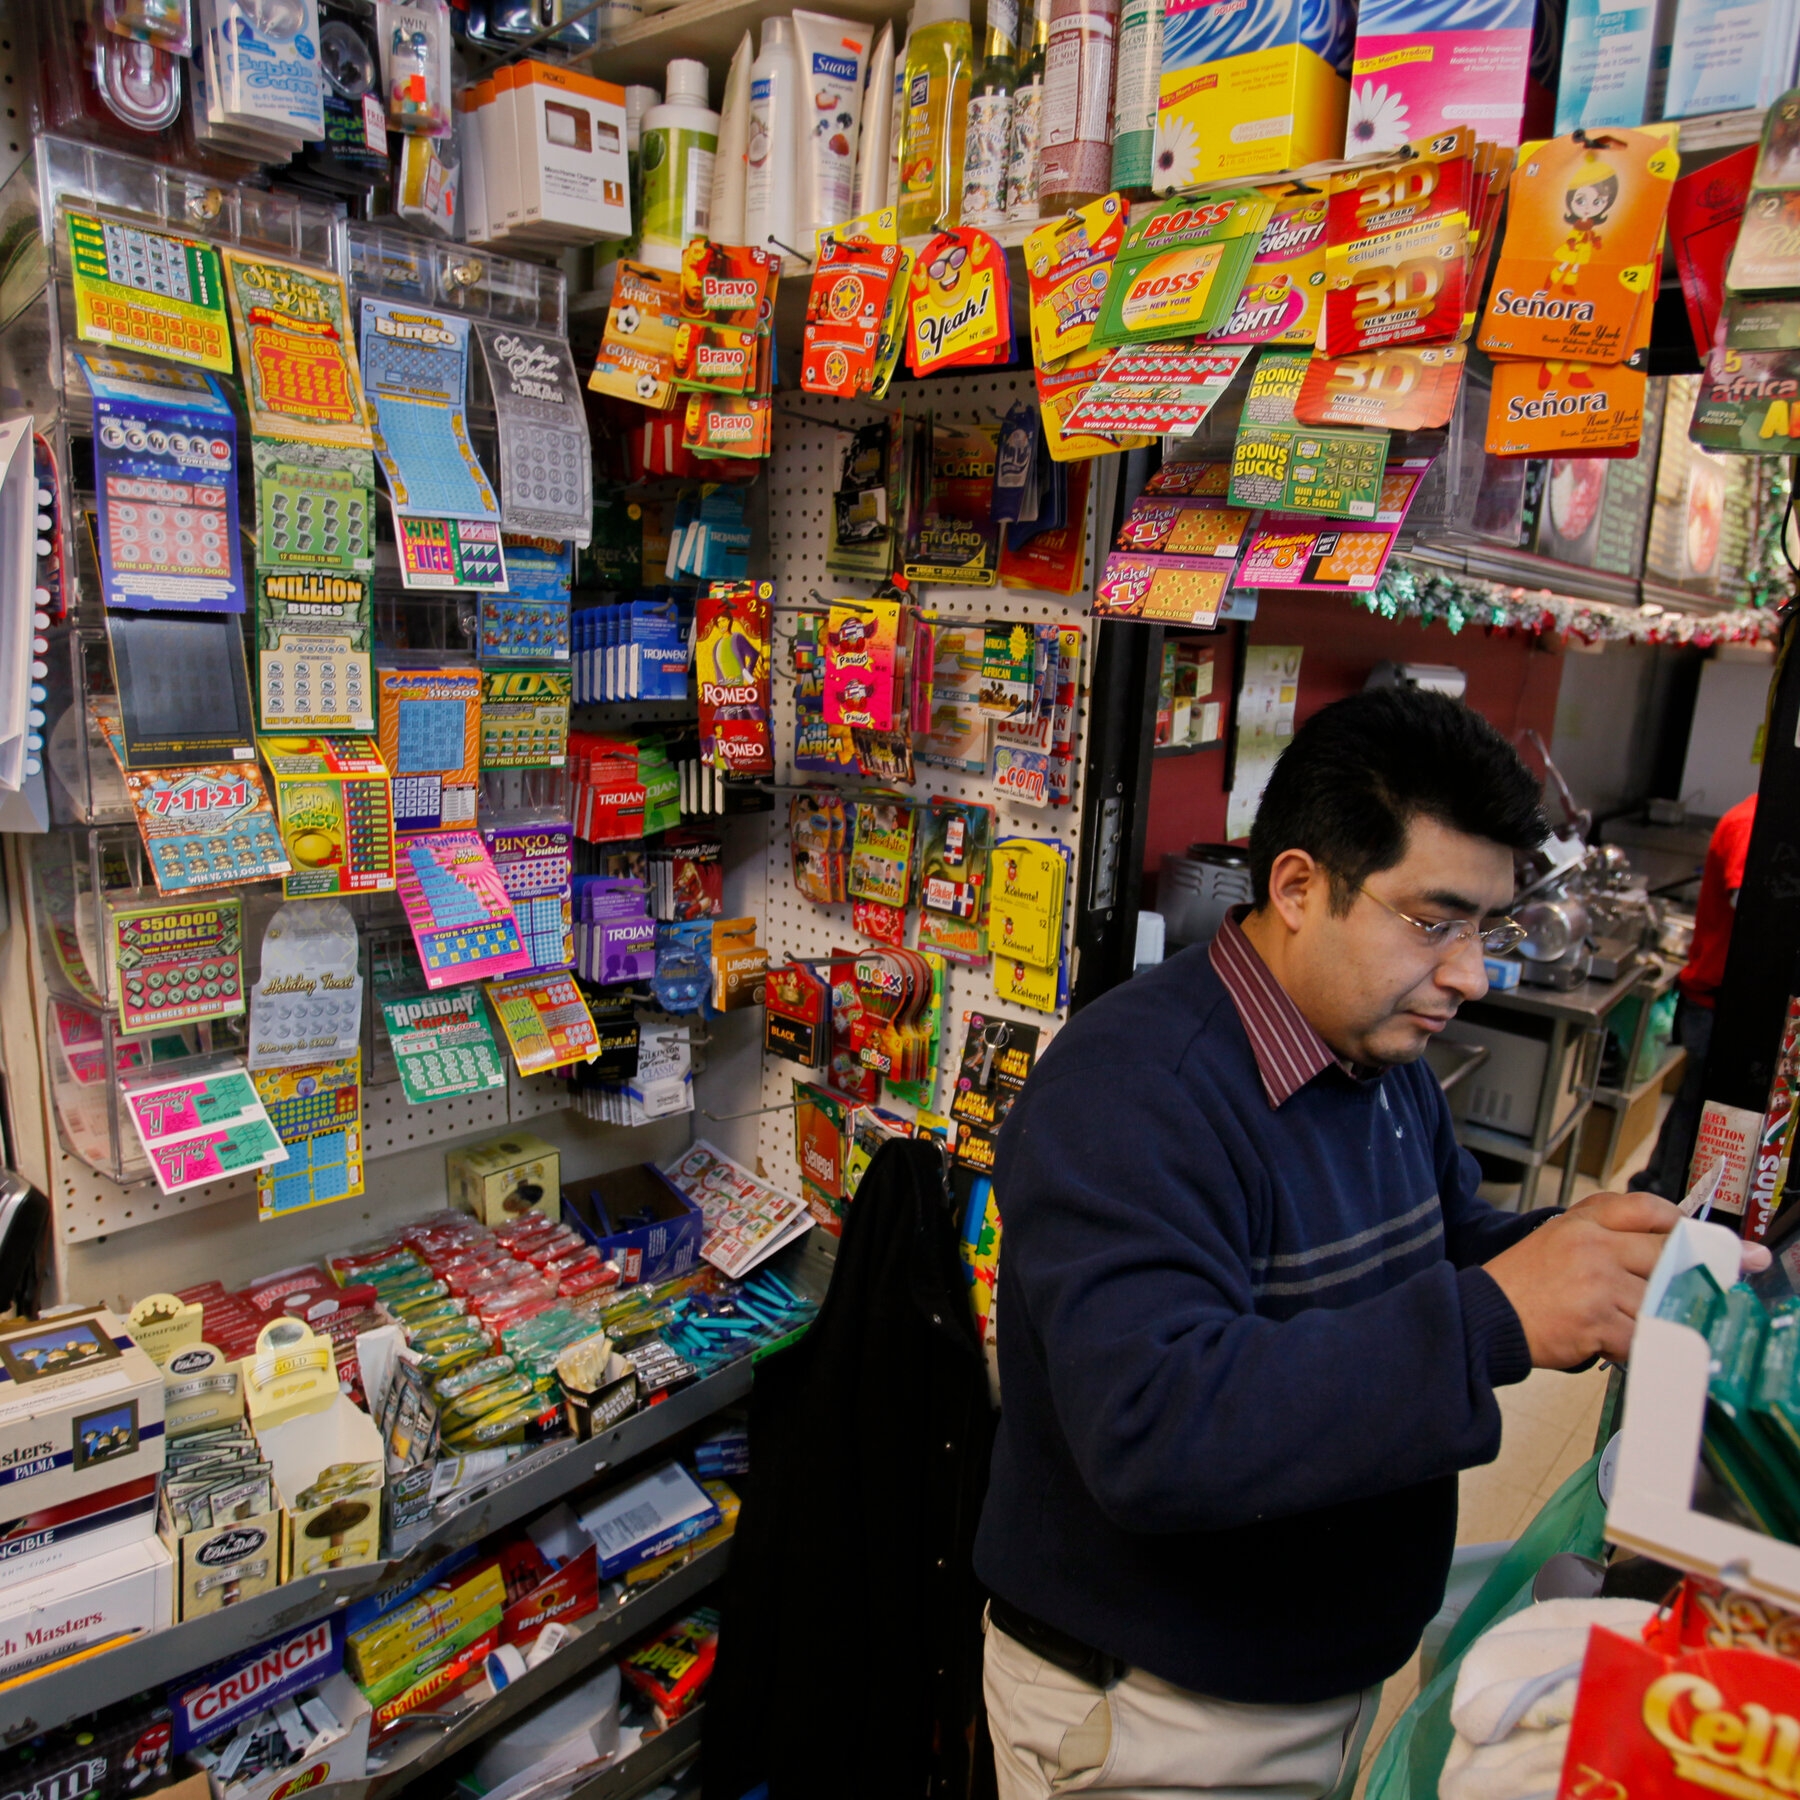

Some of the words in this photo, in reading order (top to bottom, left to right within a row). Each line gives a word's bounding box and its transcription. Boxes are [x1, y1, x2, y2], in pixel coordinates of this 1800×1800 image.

[1214, 0, 1247, 17] DOUCHE
[1594, 12, 1625, 26] fresh
[1593, 23, 1624, 37] scent
[816, 56, 856, 77] Suave
[248, 72, 318, 97] Gum
[1430, 135, 1457, 154] $2
[1650, 161, 1665, 173] $2
[1359, 164, 1438, 211] 3D
[878, 211, 894, 229] $2
[1142, 200, 1237, 239] BOSS
[1366, 211, 1388, 225] NEW
[1390, 206, 1415, 218] YORK
[1147, 236, 1173, 248] NEW
[1175, 228, 1211, 240] YORK
[1347, 231, 1393, 251] PINLESS
[1395, 220, 1442, 240] DIALING
[752, 250, 765, 264] $2
[881, 246, 896, 264] $2
[1347, 244, 1391, 264] cellular
[1405, 233, 1438, 248] home
[1438, 245, 1455, 257] $2
[243, 263, 290, 293] SET
[1130, 270, 1206, 300] BOSS
[1622, 270, 1638, 283] $2
[704, 278, 756, 296] Bravo
[1353, 262, 1441, 313] 3D
[273, 289, 333, 322] LIFE
[619, 288, 662, 306] AFRICA
[705, 297, 755, 307] AFRICA
[1150, 299, 1167, 310] NEW
[1170, 296, 1191, 307] YORK
[1493, 289, 1595, 322] Señora
[918, 288, 989, 356] Yeah!
[1206, 302, 1287, 341] RIGHT!
[1363, 315, 1390, 328] NEW
[1392, 308, 1419, 321] YORK
[375, 316, 456, 344] Bingo
[1569, 324, 1593, 338] New
[1596, 323, 1621, 340] York
[619, 355, 661, 374] AFRICA
[698, 348, 743, 364] Bravo
[1421, 350, 1436, 362] $5
[699, 363, 742, 375] AFRICA
[1255, 369, 1307, 384] BONUS
[1250, 382, 1300, 399] BUCKS
[1711, 378, 1798, 402] africa
[1333, 394, 1355, 403] NEW
[1356, 397, 1386, 408] YORK
[1507, 390, 1609, 422] Señora
[270, 402, 281, 411] 15
[282, 403, 320, 417] CHANCES
[321, 408, 331, 417] TO
[332, 410, 350, 420] WIN!
[1587, 414, 1609, 426] New
[1614, 410, 1639, 424] York
[1707, 409, 1737, 419] PREPAID
[709, 415, 753, 430] Bravo
[1699, 416, 1724, 425] PHONE
[1725, 417, 1745, 426] CARD
[101, 425, 209, 458] POWER
[711, 429, 751, 441] AFRICA
[1236, 444, 1288, 462] BONUS
[944, 463, 995, 476] CARD
[1233, 460, 1285, 481] BUCKS
[1294, 487, 1314, 496] WIN
[1316, 489, 1329, 498] UP
[1331, 490, 1341, 499] TO
[1294, 496, 1340, 509] $2,500!
[1132, 508, 1176, 522] Wicked
[401, 520, 446, 539] WIN
[942, 532, 980, 545] CARD
[1256, 532, 1317, 550] Amazing
[1319, 534, 1337, 546] PRIZE
[135, 563, 151, 571] UP
[153, 564, 167, 572] TO
[1106, 567, 1150, 582] Wicked
[266, 575, 362, 603] MILLION
[287, 603, 344, 616] BUCKS
[837, 653, 868, 666] Pasión
[982, 667, 1011, 680] AFRICAN
[489, 673, 564, 695] 10X
[702, 684, 758, 705] ROMEO
[844, 713, 870, 723] Pasión
[717, 739, 764, 757] ROMEO
[797, 737, 844, 755] AFRICA
[925, 753, 945, 762] LOCAL
[945, 755, 967, 767] ACCESS
[127, 777, 141, 787] $2
[599, 791, 645, 805] TROJAN
[494, 834, 549, 853] BINGO
[525, 845, 569, 858] Doubler
[674, 847, 701, 860] Rough
[702, 843, 722, 855] Rider
[1040, 861, 1050, 872] $2
[1004, 883, 1038, 902] Xcelente!
[140, 912, 217, 930] $50,000
[140, 927, 218, 945] DOUBLER
[433, 929, 459, 940] YOUR
[462, 923, 502, 935] LETTERS
[607, 925, 655, 942] TROJAN
[1002, 936, 1034, 955] Xcelente!
[262, 973, 316, 996] Holiday
[858, 967, 902, 992] maxx
[1010, 982, 1049, 1003] Xcelente!
[131, 1016, 142, 1025] 10
[144, 1009, 184, 1022] CHANCES
[187, 1006, 198, 1015] TO
[200, 1002, 221, 1012] WIN!
[394, 995, 475, 1027] HOLIDAY
[413, 1012, 468, 1030] TRIPLER
[771, 1026, 796, 1042] BLACK
[639, 1046, 680, 1061] WILKINSON
[861, 1047, 891, 1072] maxx
[642, 1064, 680, 1080] CLASSIC
[137, 1089, 192, 1105] Lucky
[282, 1125, 297, 1137] UP
[298, 1124, 309, 1132] TO
[1702, 1123, 1745, 1142] RATION
[156, 1137, 213, 1157] Lucky
[804, 1142, 834, 1182] Senegal
[274, 1357, 306, 1372] GOLD
[592, 1384, 632, 1420] Black
[1, 1441, 54, 1467] sters
[14, 1457, 55, 1479] PALMA
[0, 1531, 55, 1559] NCIBLE
[518, 1606, 543, 1632] Big
[543, 1596, 577, 1622] Red
[24, 1609, 104, 1650] Masters
[192, 1625, 327, 1721] CRUNCH
[378, 1664, 454, 1723] Starburs
